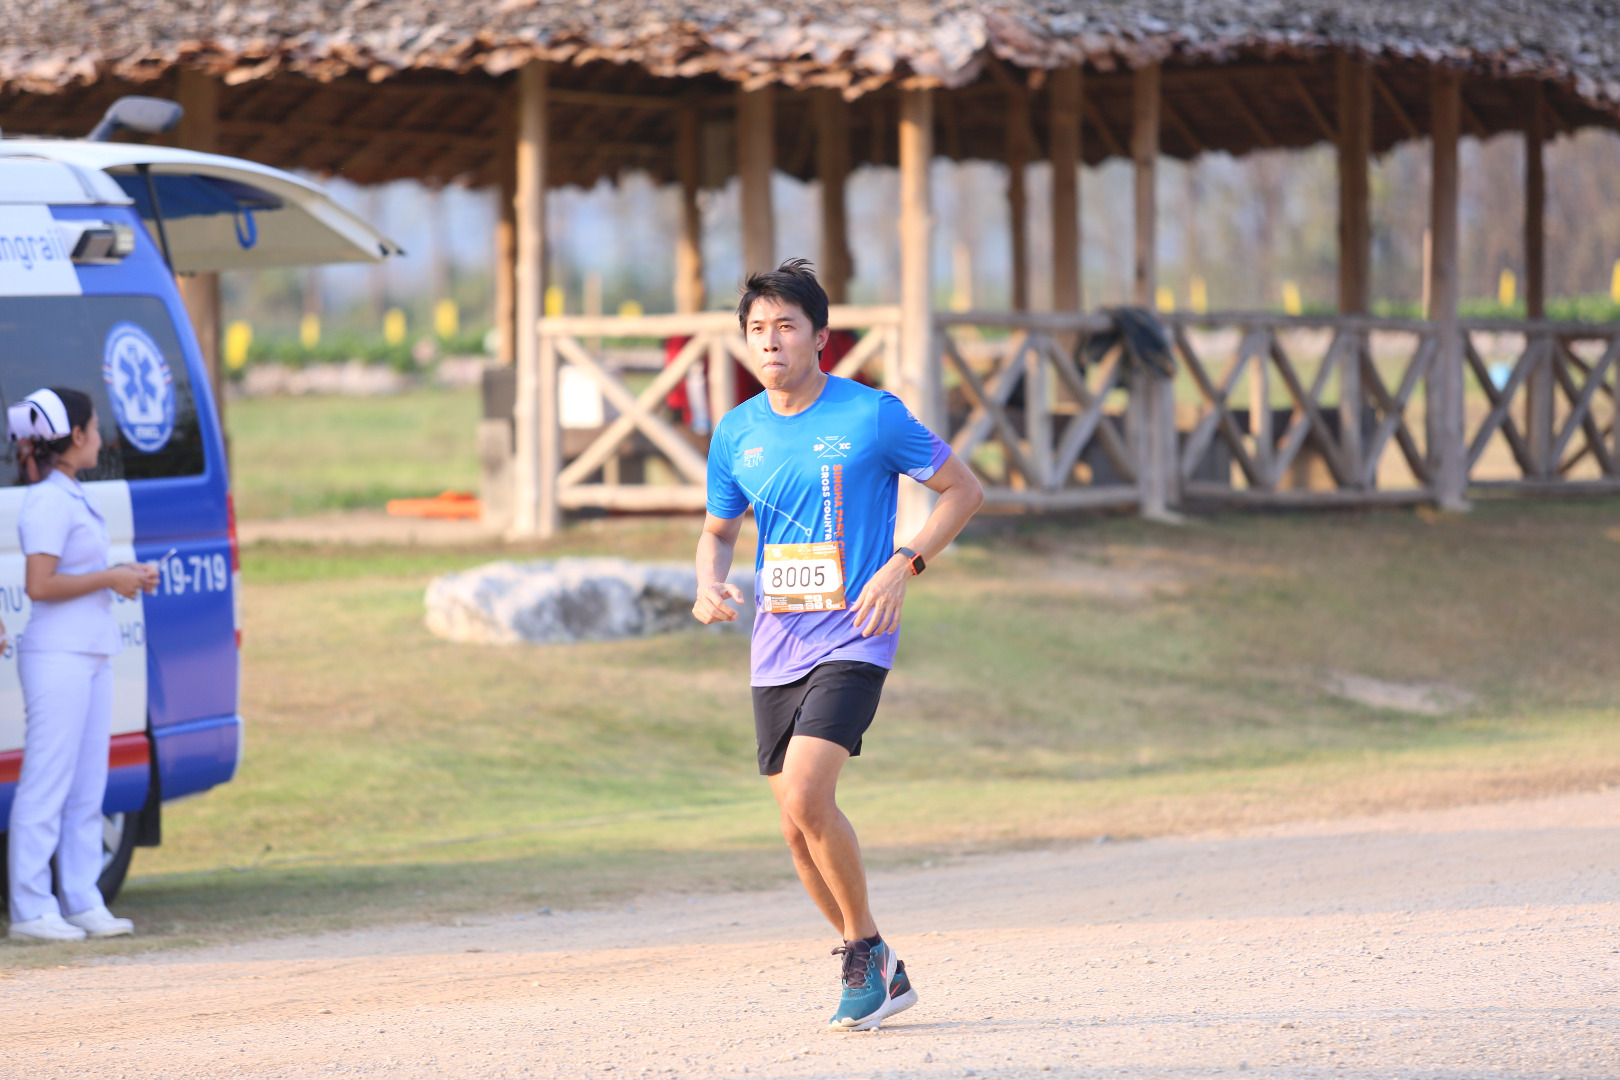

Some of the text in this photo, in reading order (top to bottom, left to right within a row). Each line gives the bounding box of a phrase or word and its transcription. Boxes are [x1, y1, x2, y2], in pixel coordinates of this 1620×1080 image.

[813, 442, 851, 452] SP XC
[833, 464, 843, 508] SINGHA
[821, 464, 833, 543] CROSS COUNTR
[835, 509, 845, 539] PARK
[772, 565, 825, 588] 8005
